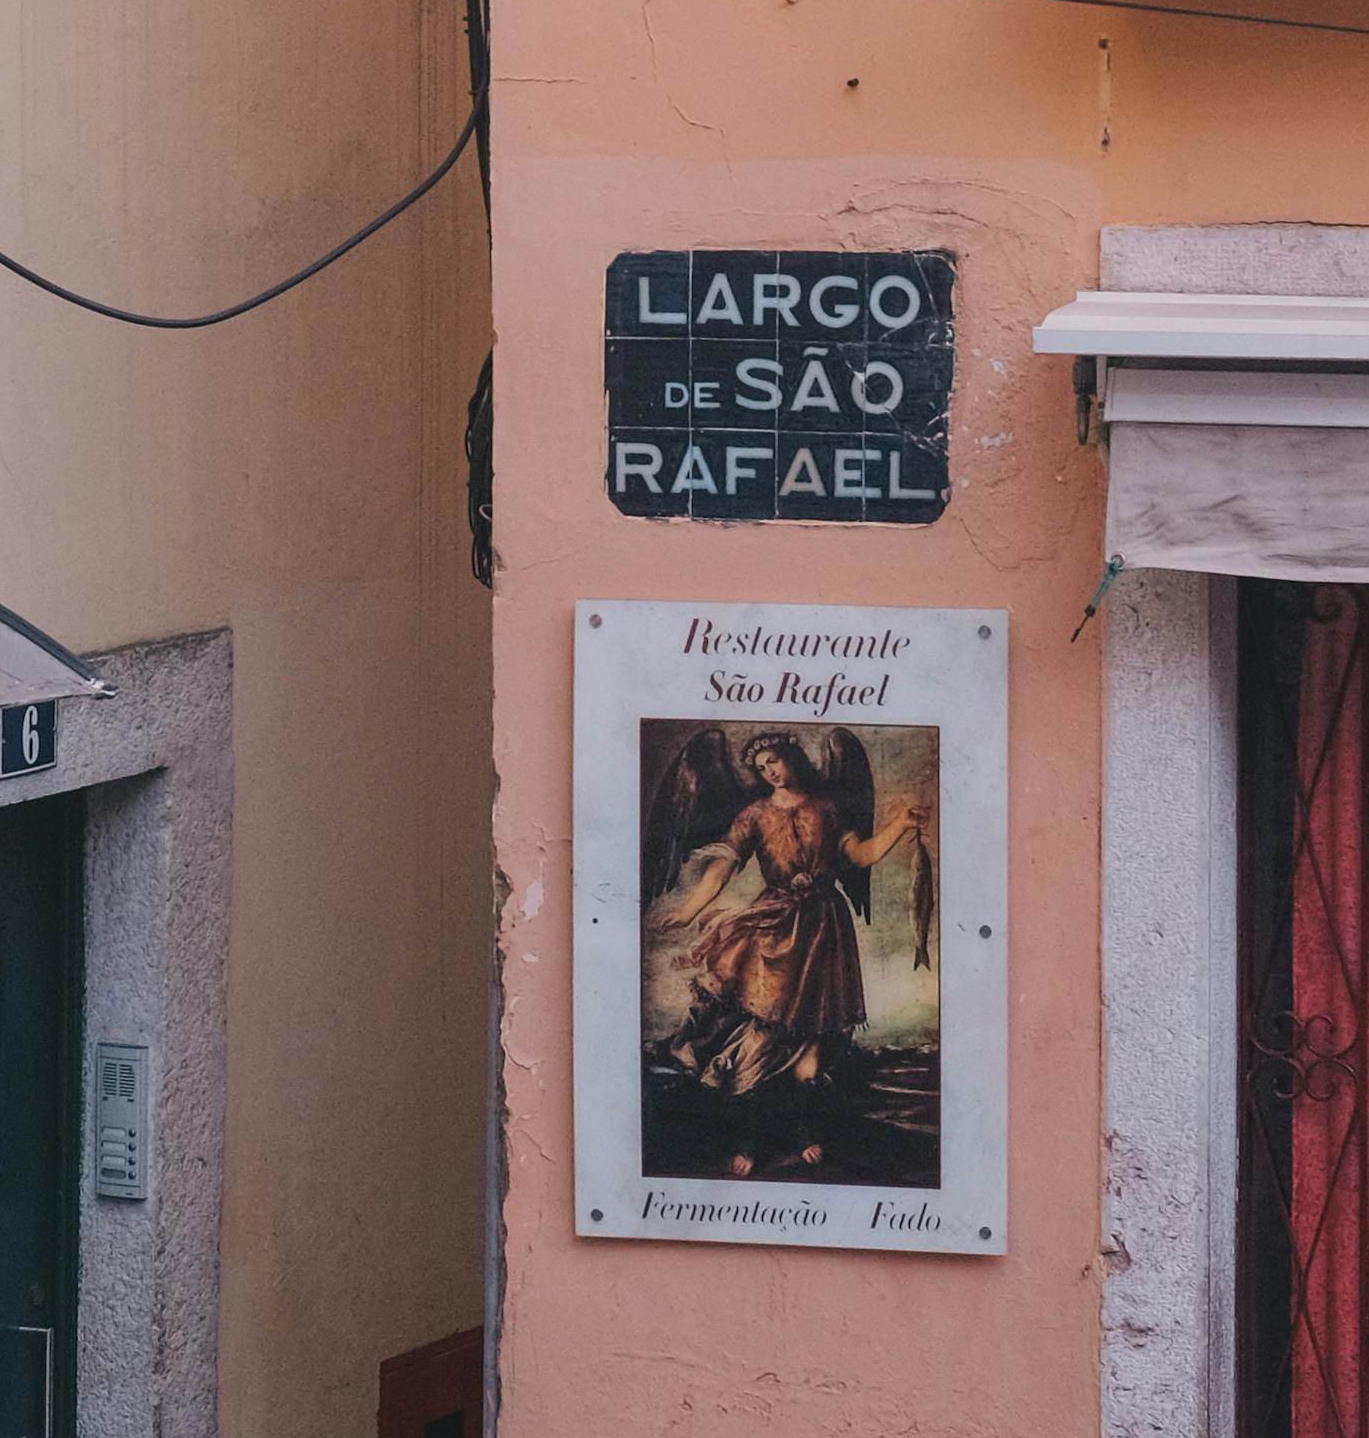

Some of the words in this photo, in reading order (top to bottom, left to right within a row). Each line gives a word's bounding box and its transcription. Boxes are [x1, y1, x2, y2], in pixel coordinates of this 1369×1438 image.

[638, 273, 921, 329] LARGO
[664, 382, 721, 408] DE
[735, 347, 904, 414] SÃO
[614, 442, 936, 500] RAFAEL
[682, 617, 911, 660] Restaurante
[704, 669, 765, 704] São
[774, 671, 891, 718] Rafael
[22, 705, 40, 764] 6
[641, 1191, 828, 1232] Fermentação
[870, 1200, 942, 1232] Fado
